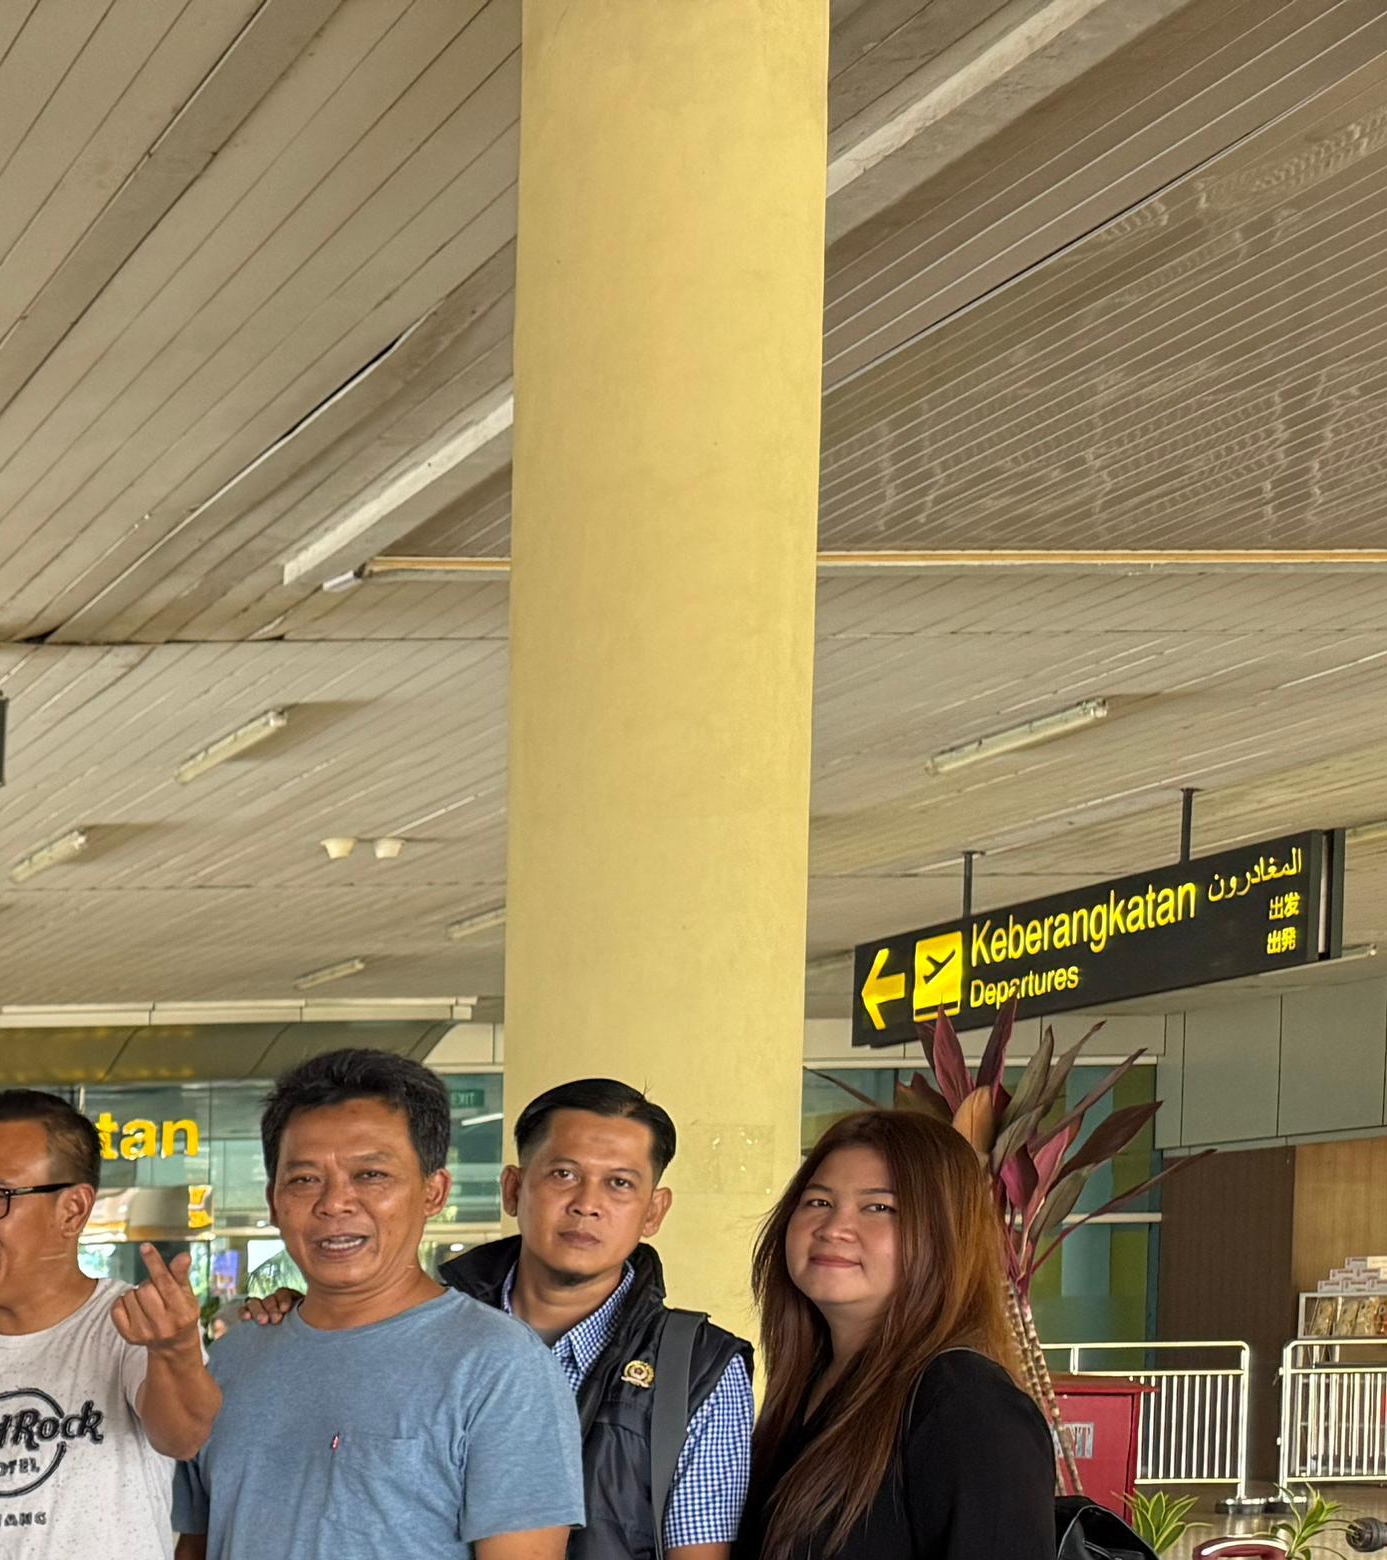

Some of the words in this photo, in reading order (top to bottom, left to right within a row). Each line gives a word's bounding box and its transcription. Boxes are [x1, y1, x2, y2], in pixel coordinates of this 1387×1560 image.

[1208, 847, 1302, 902] المغادرون
[970, 880, 1197, 968] Keberangkatan
[970, 963, 1080, 1010] Departures
